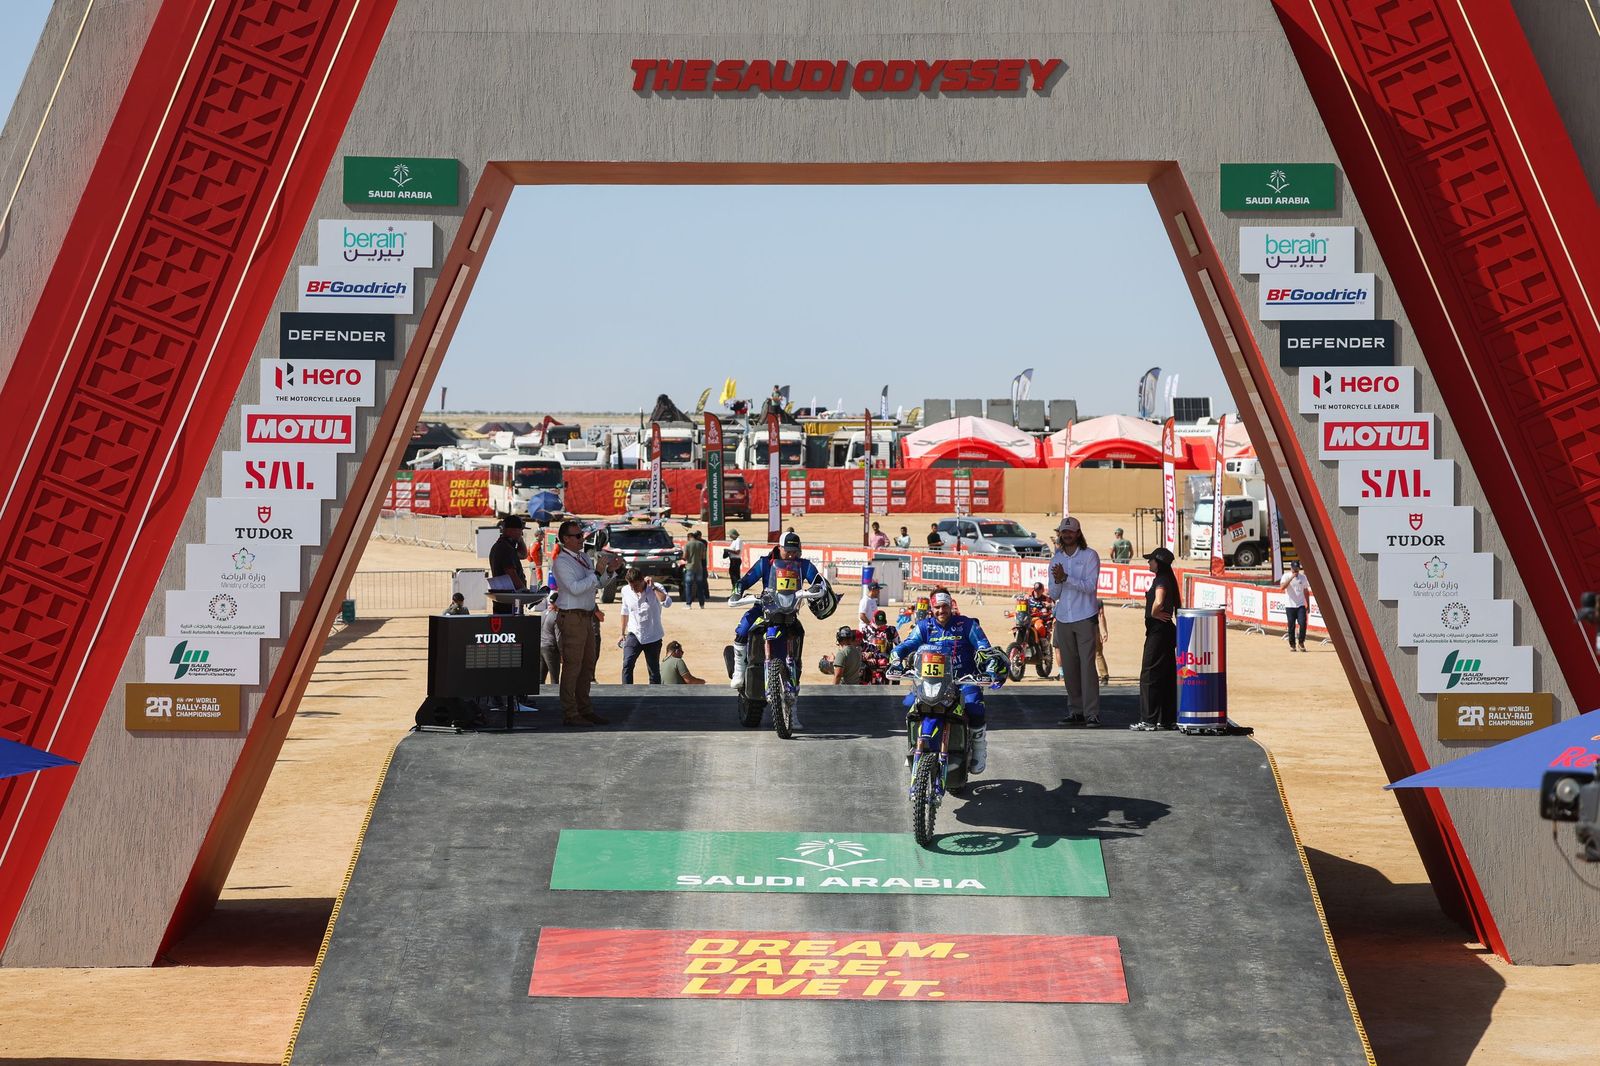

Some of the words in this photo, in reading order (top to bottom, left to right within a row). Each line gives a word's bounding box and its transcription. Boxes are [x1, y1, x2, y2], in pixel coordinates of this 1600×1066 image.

[631, 59, 709, 91] THE
[712, 59, 850, 92] SAUDI
[851, 59, 1062, 92] ODYSSEY
[368, 190, 396, 199] SAUDI
[397, 191, 433, 199] ARABIA
[1245, 196, 1273, 204] SAUDI
[1275, 197, 1310, 205] ARABIA
[343, 226, 405, 249] berain
[1265, 232, 1327, 255] berain
[306, 281, 407, 294] BFGoodrich
[1266, 288, 1367, 301] BFGoodrich
[288, 329, 386, 342] DEFENDER
[1287, 337, 1385, 349] DEFENDER
[251, 418, 347, 440] MOTUL
[1328, 425, 1425, 447] MOTUL
[450, 498, 475, 507] LIVE
[1166, 480, 1174, 540] MOTUL
[235, 528, 293, 540] TUDOR
[1232, 528, 1244, 538] 133
[1387, 535, 1445, 547] TUDOR
[923, 563, 959, 575] DEFENDER
[785, 578, 790, 589] 7
[475, 633, 516, 644] TUDOR
[1186, 652, 1210, 665] Bull
[926, 664, 939, 676] 15
[1488, 712, 1533, 720] RALLY-RAID
[676, 875, 804, 888] SAUDI
[818, 877, 987, 890] ARABIA
[684, 938, 971, 959] DREAM.
[682, 959, 902, 976] DARE.
[679, 977, 849, 996] LIVE
[859, 977, 946, 998] IT.
